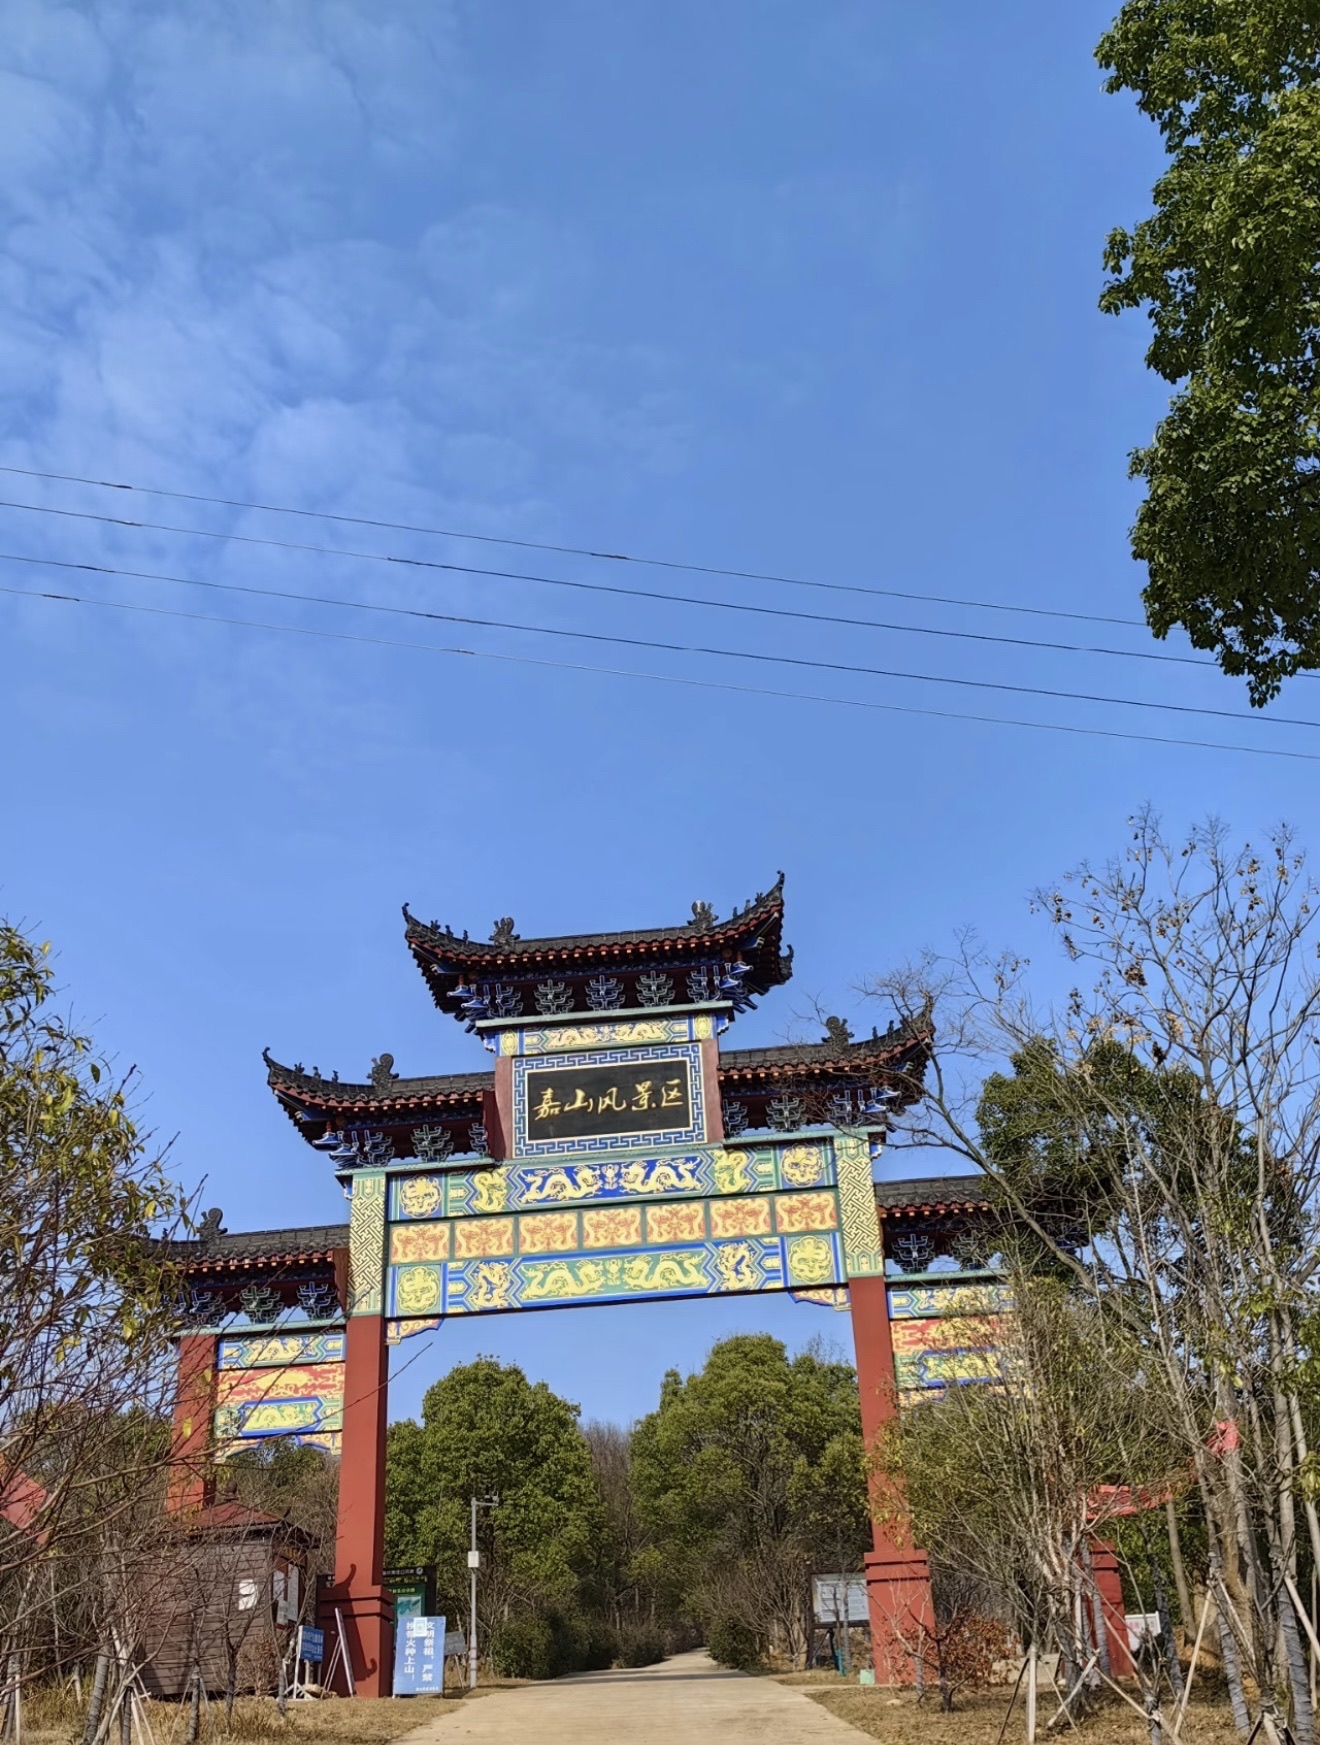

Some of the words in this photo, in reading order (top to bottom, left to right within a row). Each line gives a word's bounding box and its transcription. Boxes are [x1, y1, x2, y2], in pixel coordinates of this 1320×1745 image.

[533, 1078, 685, 1121] 嘉山风景区
